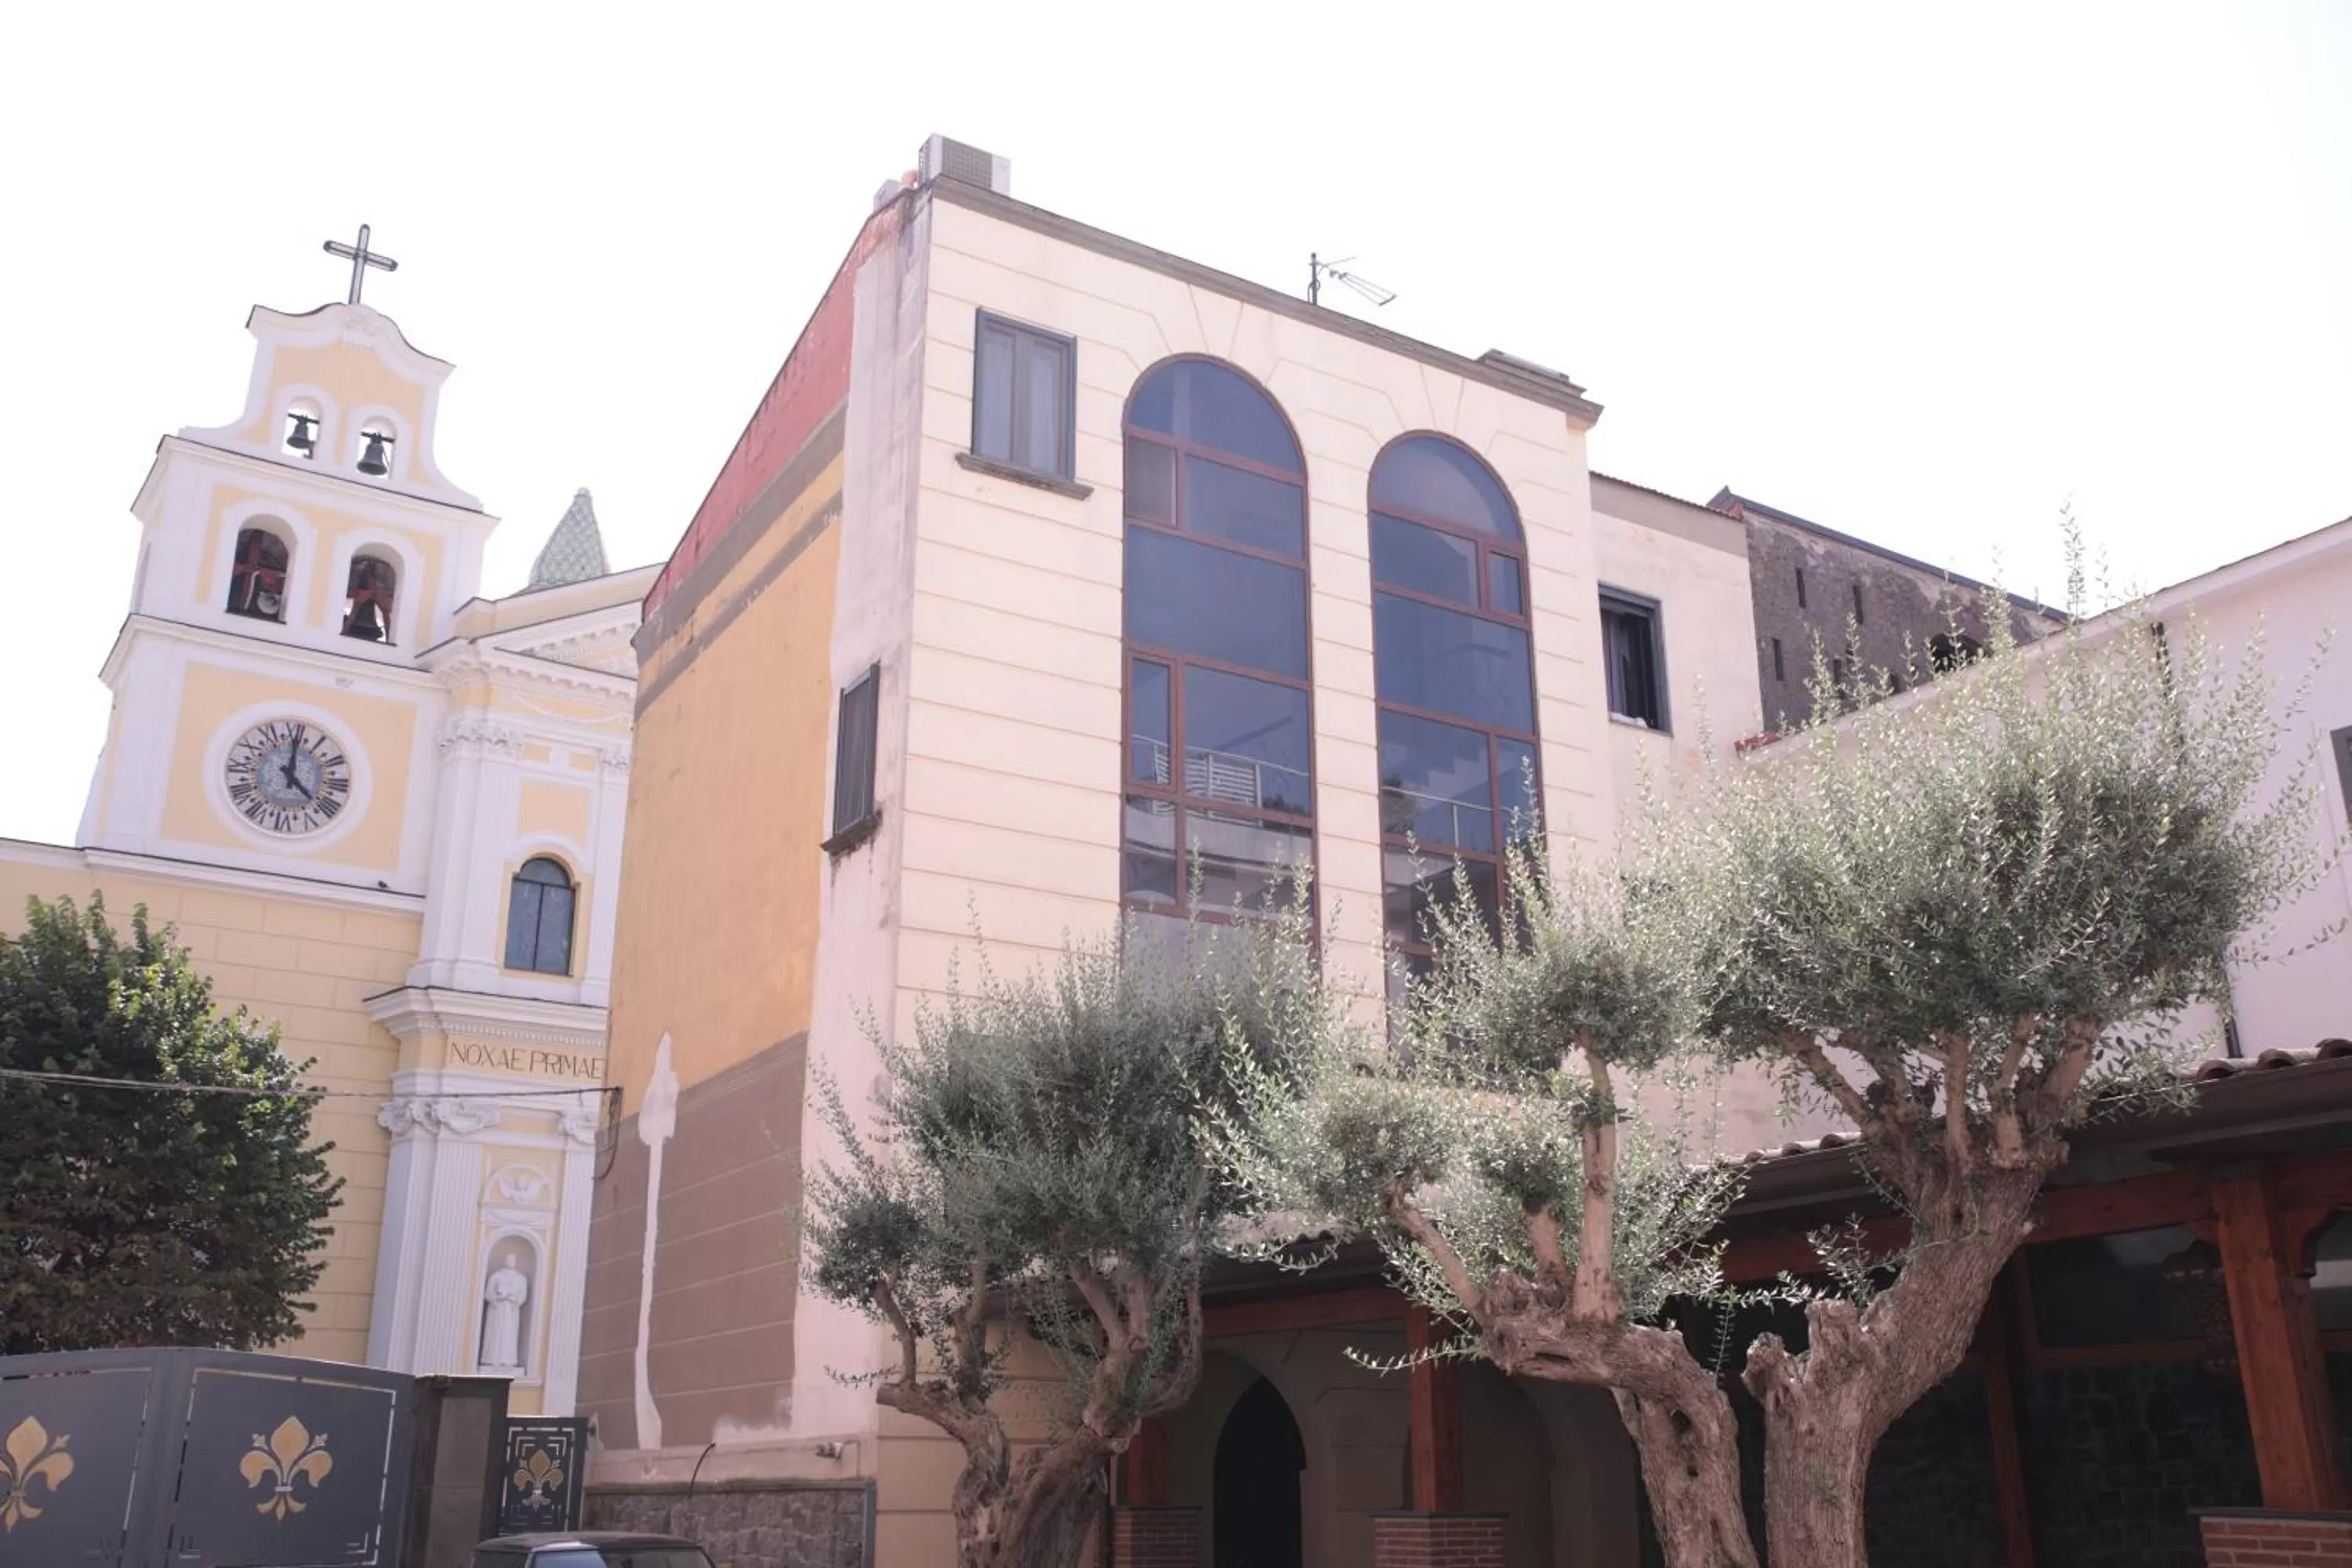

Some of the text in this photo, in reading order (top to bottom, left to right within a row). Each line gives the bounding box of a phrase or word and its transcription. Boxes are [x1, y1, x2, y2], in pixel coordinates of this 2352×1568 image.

[257, 722, 278, 743] XI
[238, 735, 261, 757] X
[312, 735, 327, 751] I
[227, 757, 252, 774] IX
[325, 754, 346, 768] II
[328, 778, 349, 793] III
[245, 800, 267, 825] VII
[274, 811, 291, 833] VI
[304, 811, 319, 831] V
[451, 1041, 604, 1080] NOXAE PRIMAE
